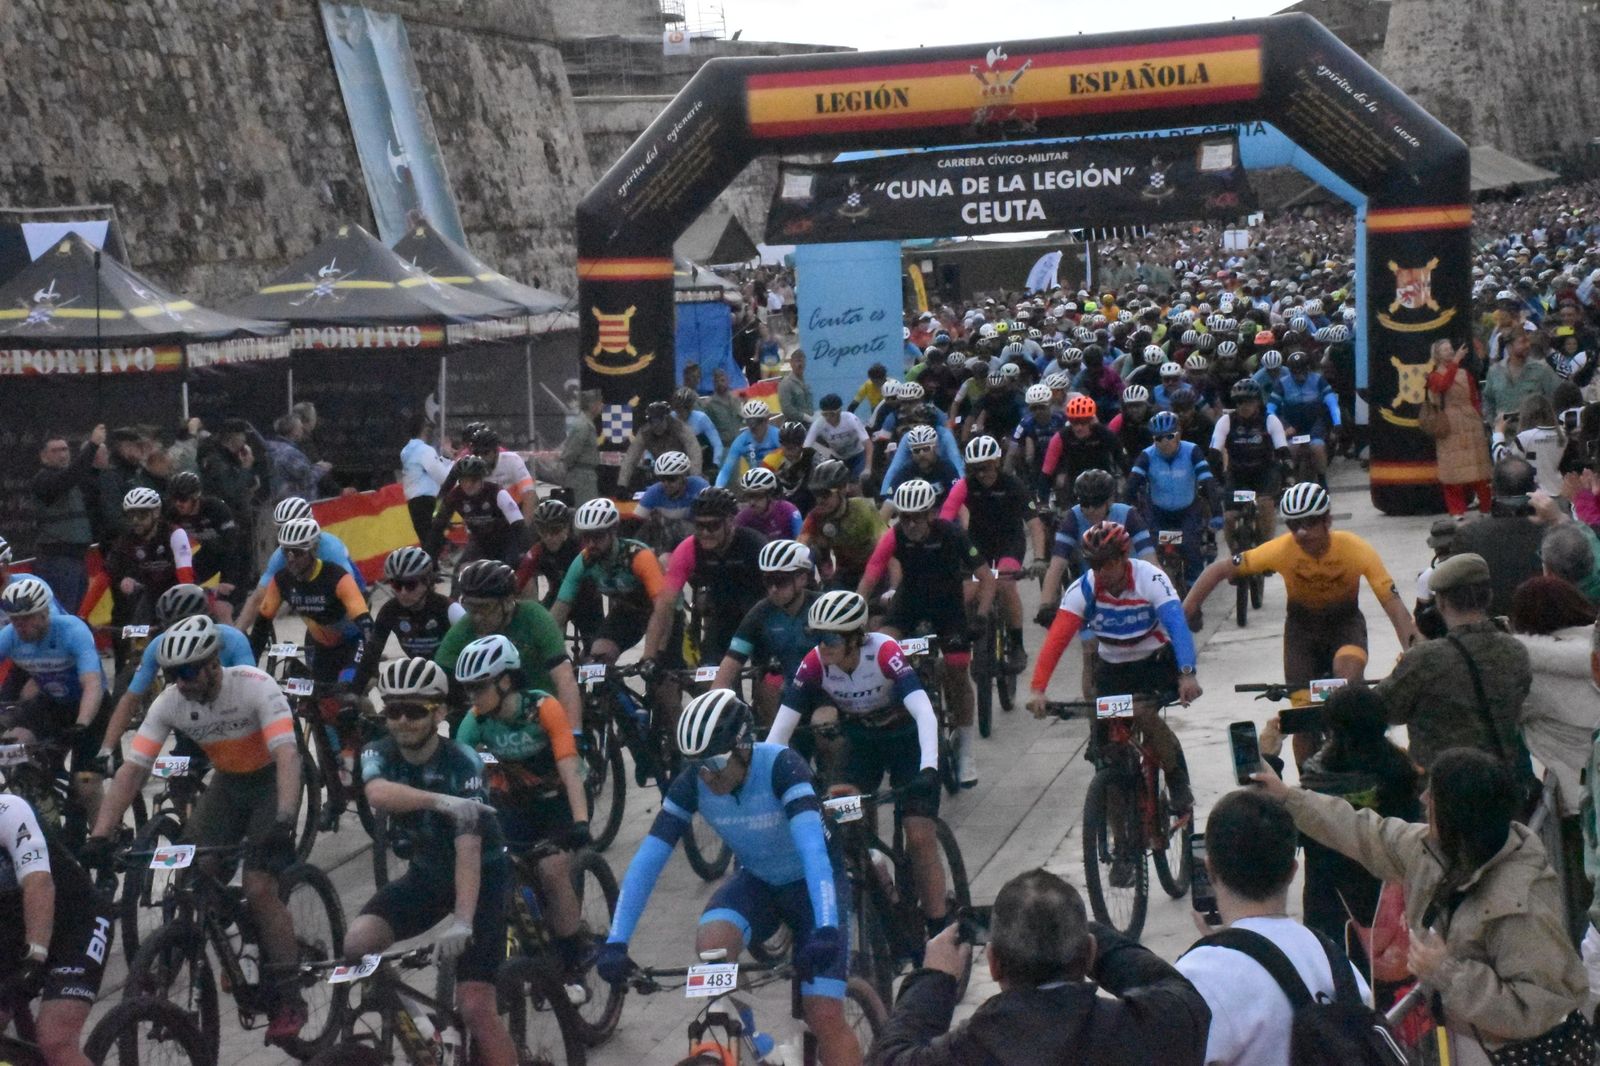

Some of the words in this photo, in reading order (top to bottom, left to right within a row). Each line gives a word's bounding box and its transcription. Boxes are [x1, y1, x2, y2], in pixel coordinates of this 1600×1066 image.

[814, 83, 909, 114] LEGIÓN
[1069, 62, 1210, 94] ESPAÑOLA
[645, 145, 659, 165] del
[937, 156, 985, 168] CARRERA
[988, 151, 1069, 166] CÍVICO-MILITAR
[962, 176, 989, 195] DE
[998, 174, 1026, 193] LA
[961, 199, 1046, 224] CEUTA
[808, 307, 864, 331] Ceuta
[869, 309, 886, 321] es
[812, 334, 889, 367] Deporte
[168, 761, 187, 770] 238
[839, 802, 857, 815] 181
[86, 916, 110, 965] BH
[706, 973, 733, 987] 483
